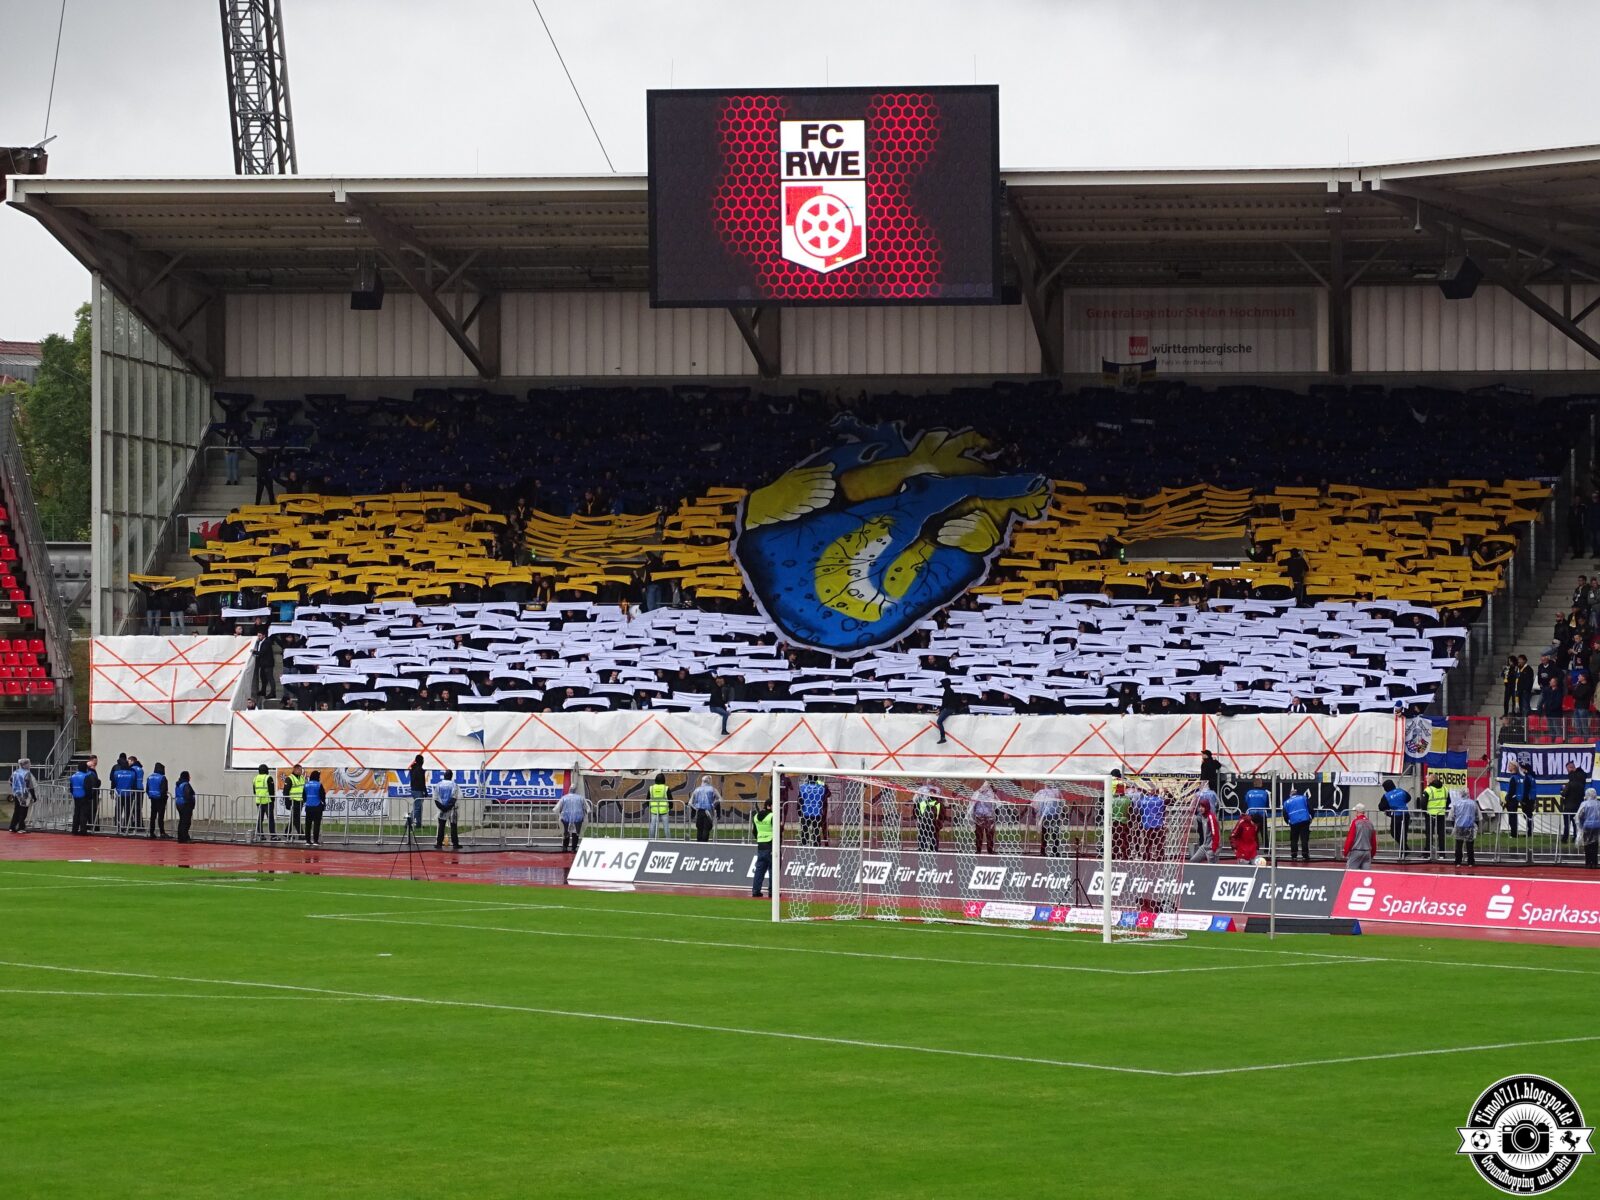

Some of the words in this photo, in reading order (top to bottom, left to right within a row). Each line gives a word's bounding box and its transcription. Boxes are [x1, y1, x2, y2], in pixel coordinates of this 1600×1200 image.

[800, 123, 845, 149] FC
[785, 150, 860, 177] RWE
[1086, 307, 1183, 321] Generalagentur
[1186, 307, 1226, 319] Stefan
[1229, 306, 1296, 319] Hochmuth
[1151, 343, 1252, 356] württembergische
[1340, 775, 1378, 784] CHAOTEN
[649, 855, 675, 870] SWE
[679, 856, 701, 872] Für
[699, 857, 735, 873] Erfurt.
[784, 861, 805, 877] Für
[804, 862, 842, 878] Erfurt.
[860, 864, 888, 881] SWE
[893, 867, 915, 883] Für
[915, 867, 954, 884] Erfurt.
[973, 870, 1001, 887] SWE
[1009, 871, 1031, 888] Für
[1130, 877, 1153, 894] Für
[1153, 878, 1196, 896] Erfurt.
[1217, 881, 1249, 898] SWE
[1258, 882, 1283, 900] Für
[1282, 883, 1328, 902] Erfurt.
[1379, 894, 1467, 917] Sparkasse
[1518, 902, 1600, 925] Sparkass
